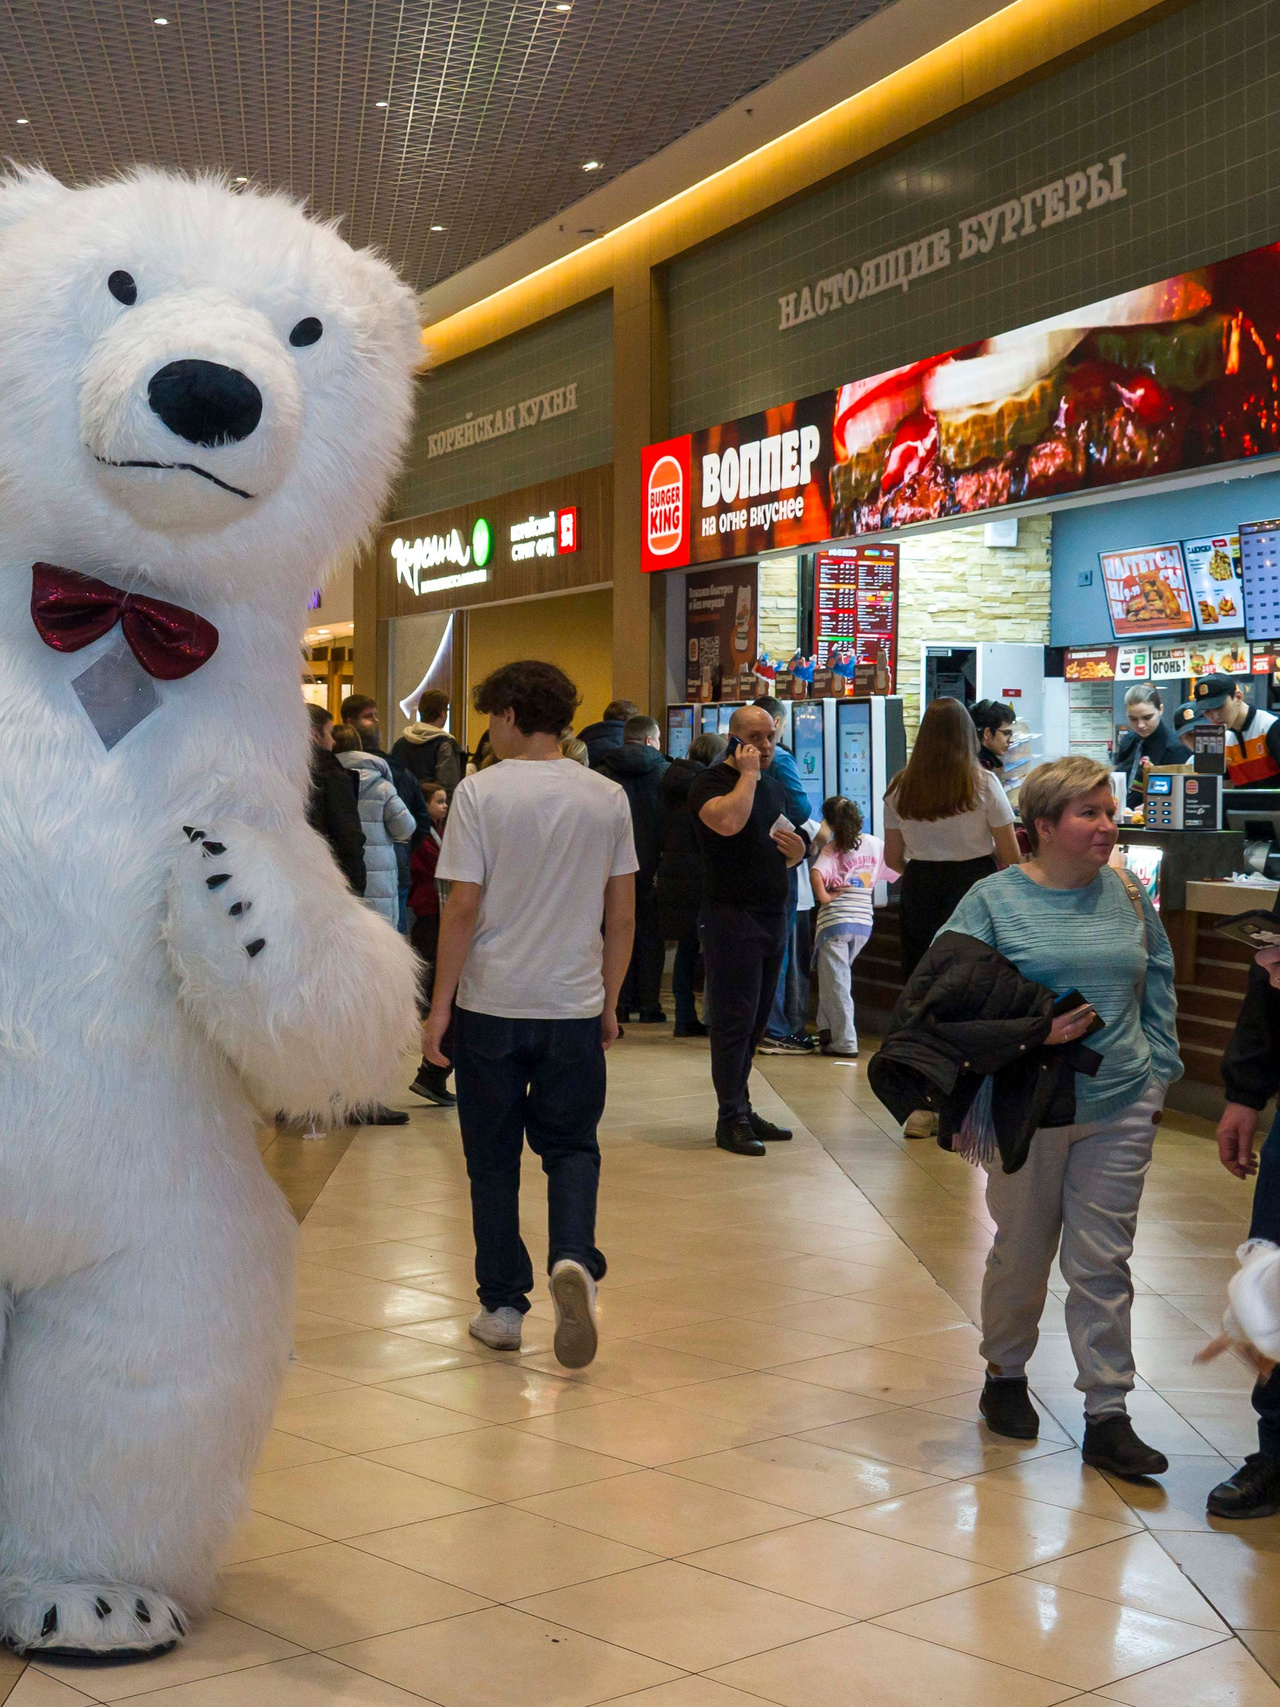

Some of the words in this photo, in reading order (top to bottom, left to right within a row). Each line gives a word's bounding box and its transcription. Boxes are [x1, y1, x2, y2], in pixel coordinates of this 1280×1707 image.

[778, 227, 951, 331] НАСТОЯЩИЕ
[958, 152, 1128, 260] БУРГЕРЫ
[427, 406, 516, 459] КОРЕЙСКАЯ
[518, 382, 579, 430] КУХНЯ
[702, 424, 820, 509] ВОППЕР
[650, 485, 681, 508] BURGER
[701, 517, 717, 537] на
[719, 509, 748, 534] огне
[749, 496, 805, 531] вкуснее
[650, 505, 681, 535] KING
[1103, 549, 1181, 580] НАГГЕТСЫ
